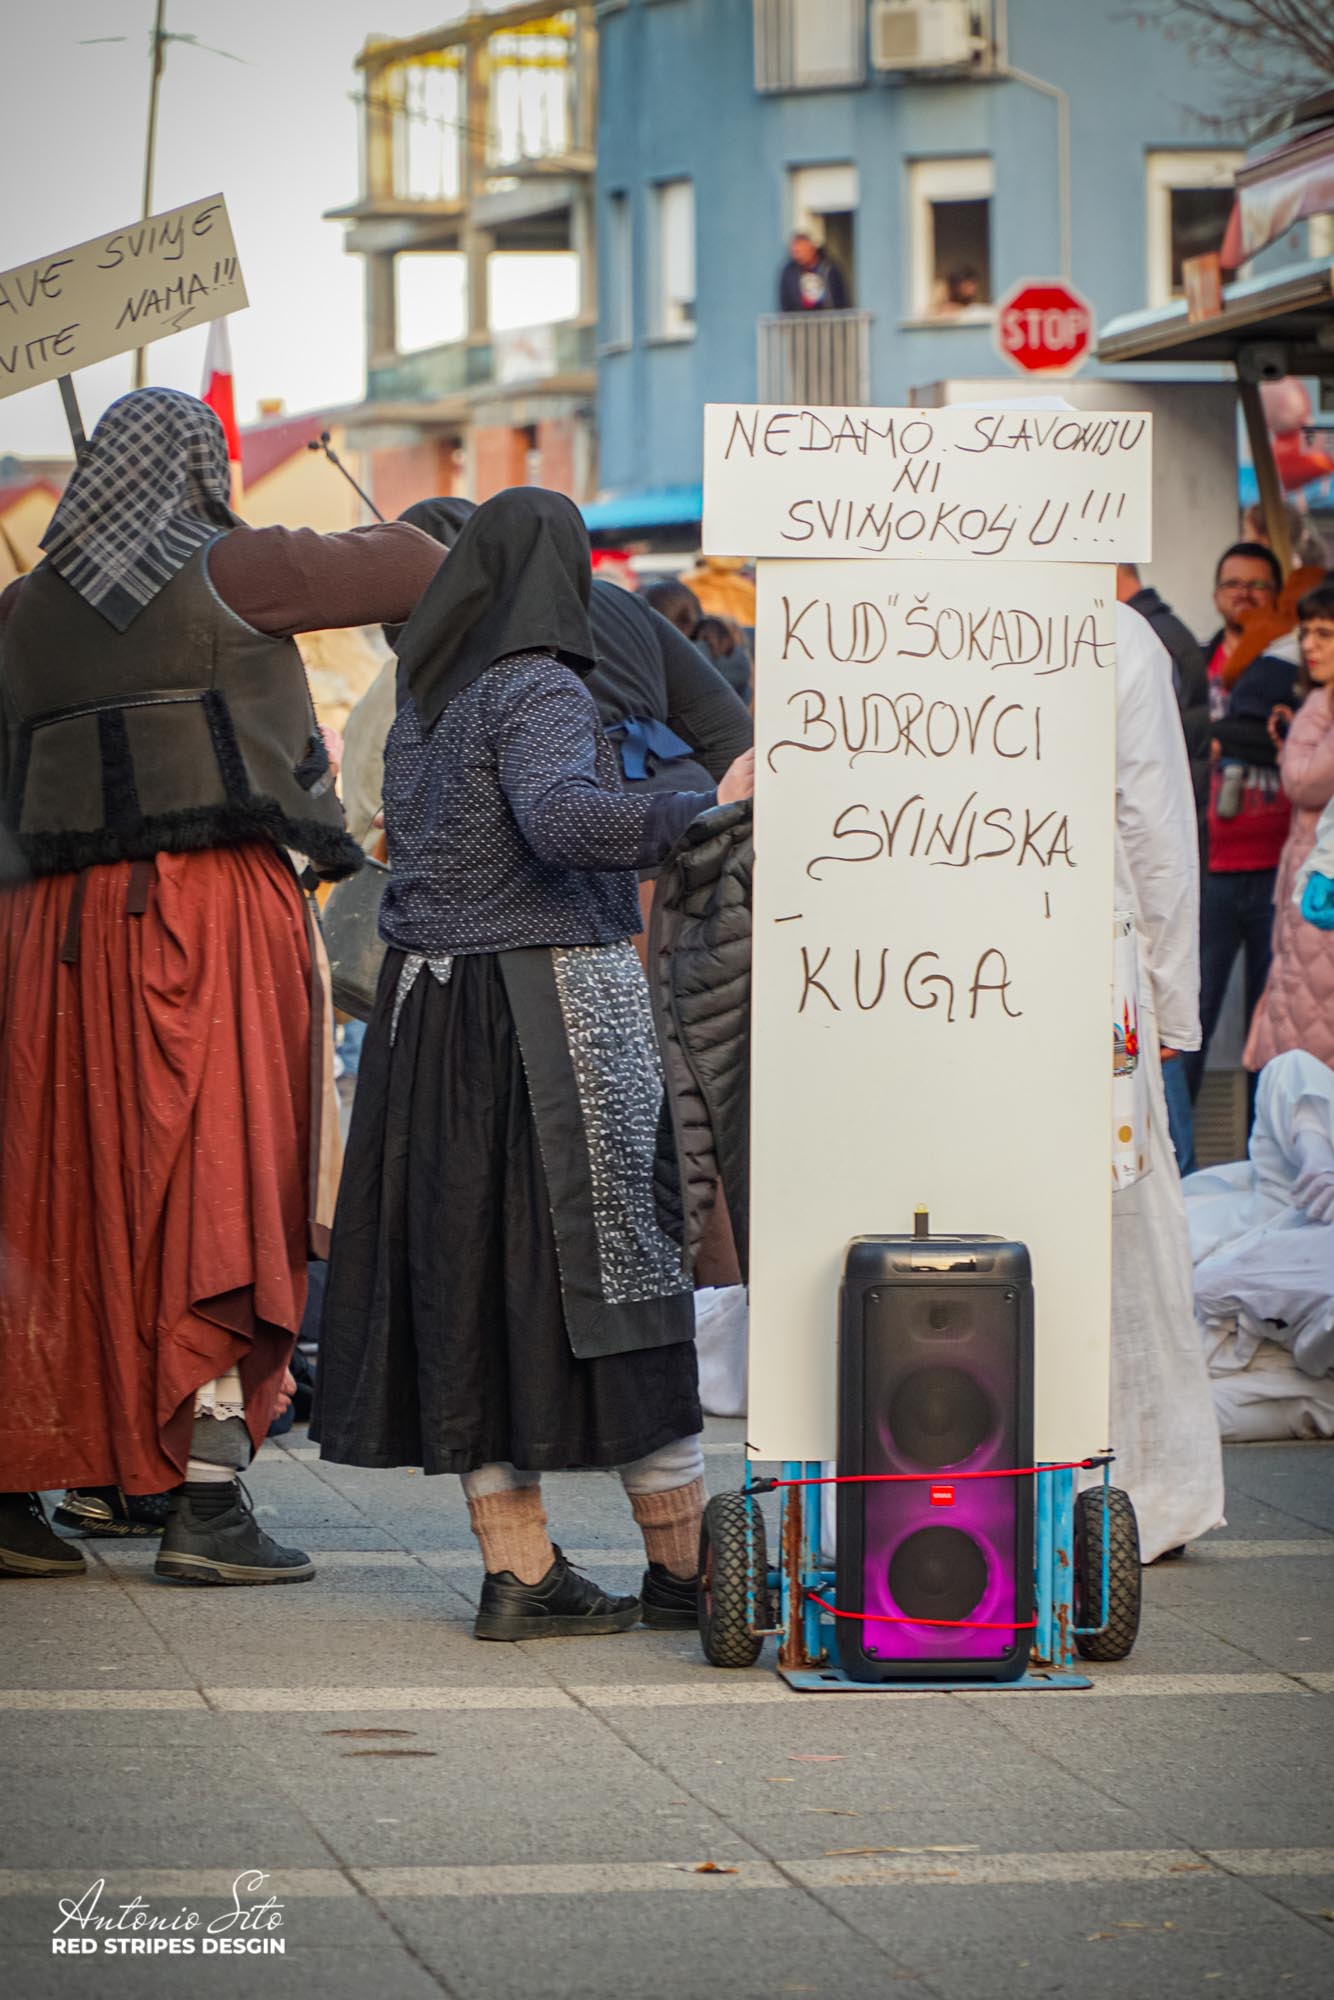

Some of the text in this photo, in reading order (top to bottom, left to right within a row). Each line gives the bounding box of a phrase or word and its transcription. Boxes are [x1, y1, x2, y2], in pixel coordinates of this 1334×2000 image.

[1003, 307, 1088, 351] STOP
[892, 458, 940, 493] NI
[768, 689, 1041, 773] BUDROVCI
[806, 791, 1078, 881] SVINJSKA
[798, 946, 1023, 1023] KUGA
